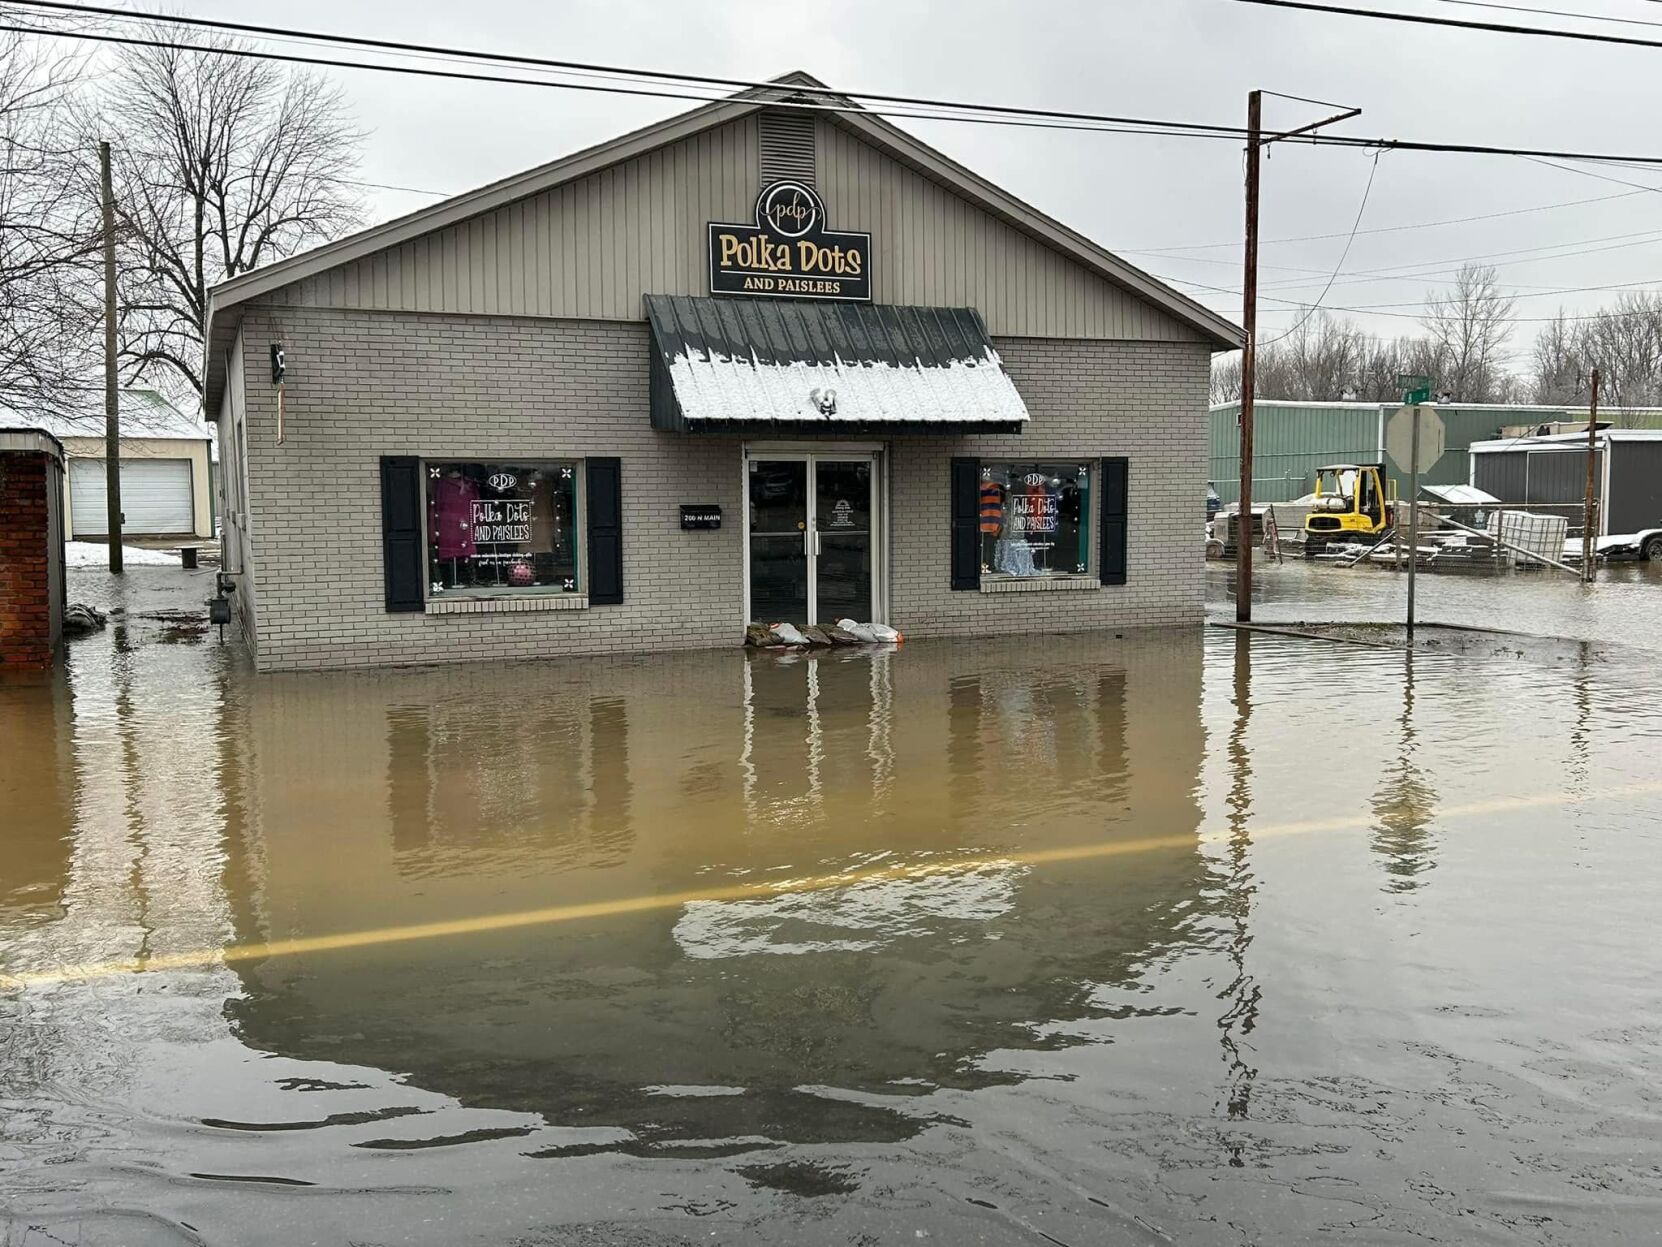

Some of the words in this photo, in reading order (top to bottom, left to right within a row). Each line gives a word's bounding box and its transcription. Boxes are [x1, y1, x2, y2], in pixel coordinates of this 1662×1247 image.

[760, 191, 822, 230] pdp
[719, 234, 792, 271] Polka
[797, 240, 861, 275] Dots
[744, 277, 774, 290] AND
[778, 279, 841, 294] PAISLEES
[493, 474, 515, 487] PDP
[473, 503, 502, 523] Polka
[506, 503, 529, 523] Dots
[1013, 498, 1035, 515] Polka
[1037, 498, 1055, 515] Dots
[1013, 516, 1026, 530] AND
[1027, 516, 1054, 530] PAISLEES
[474, 525, 491, 541] AND
[492, 524, 530, 541] PAISLEES
